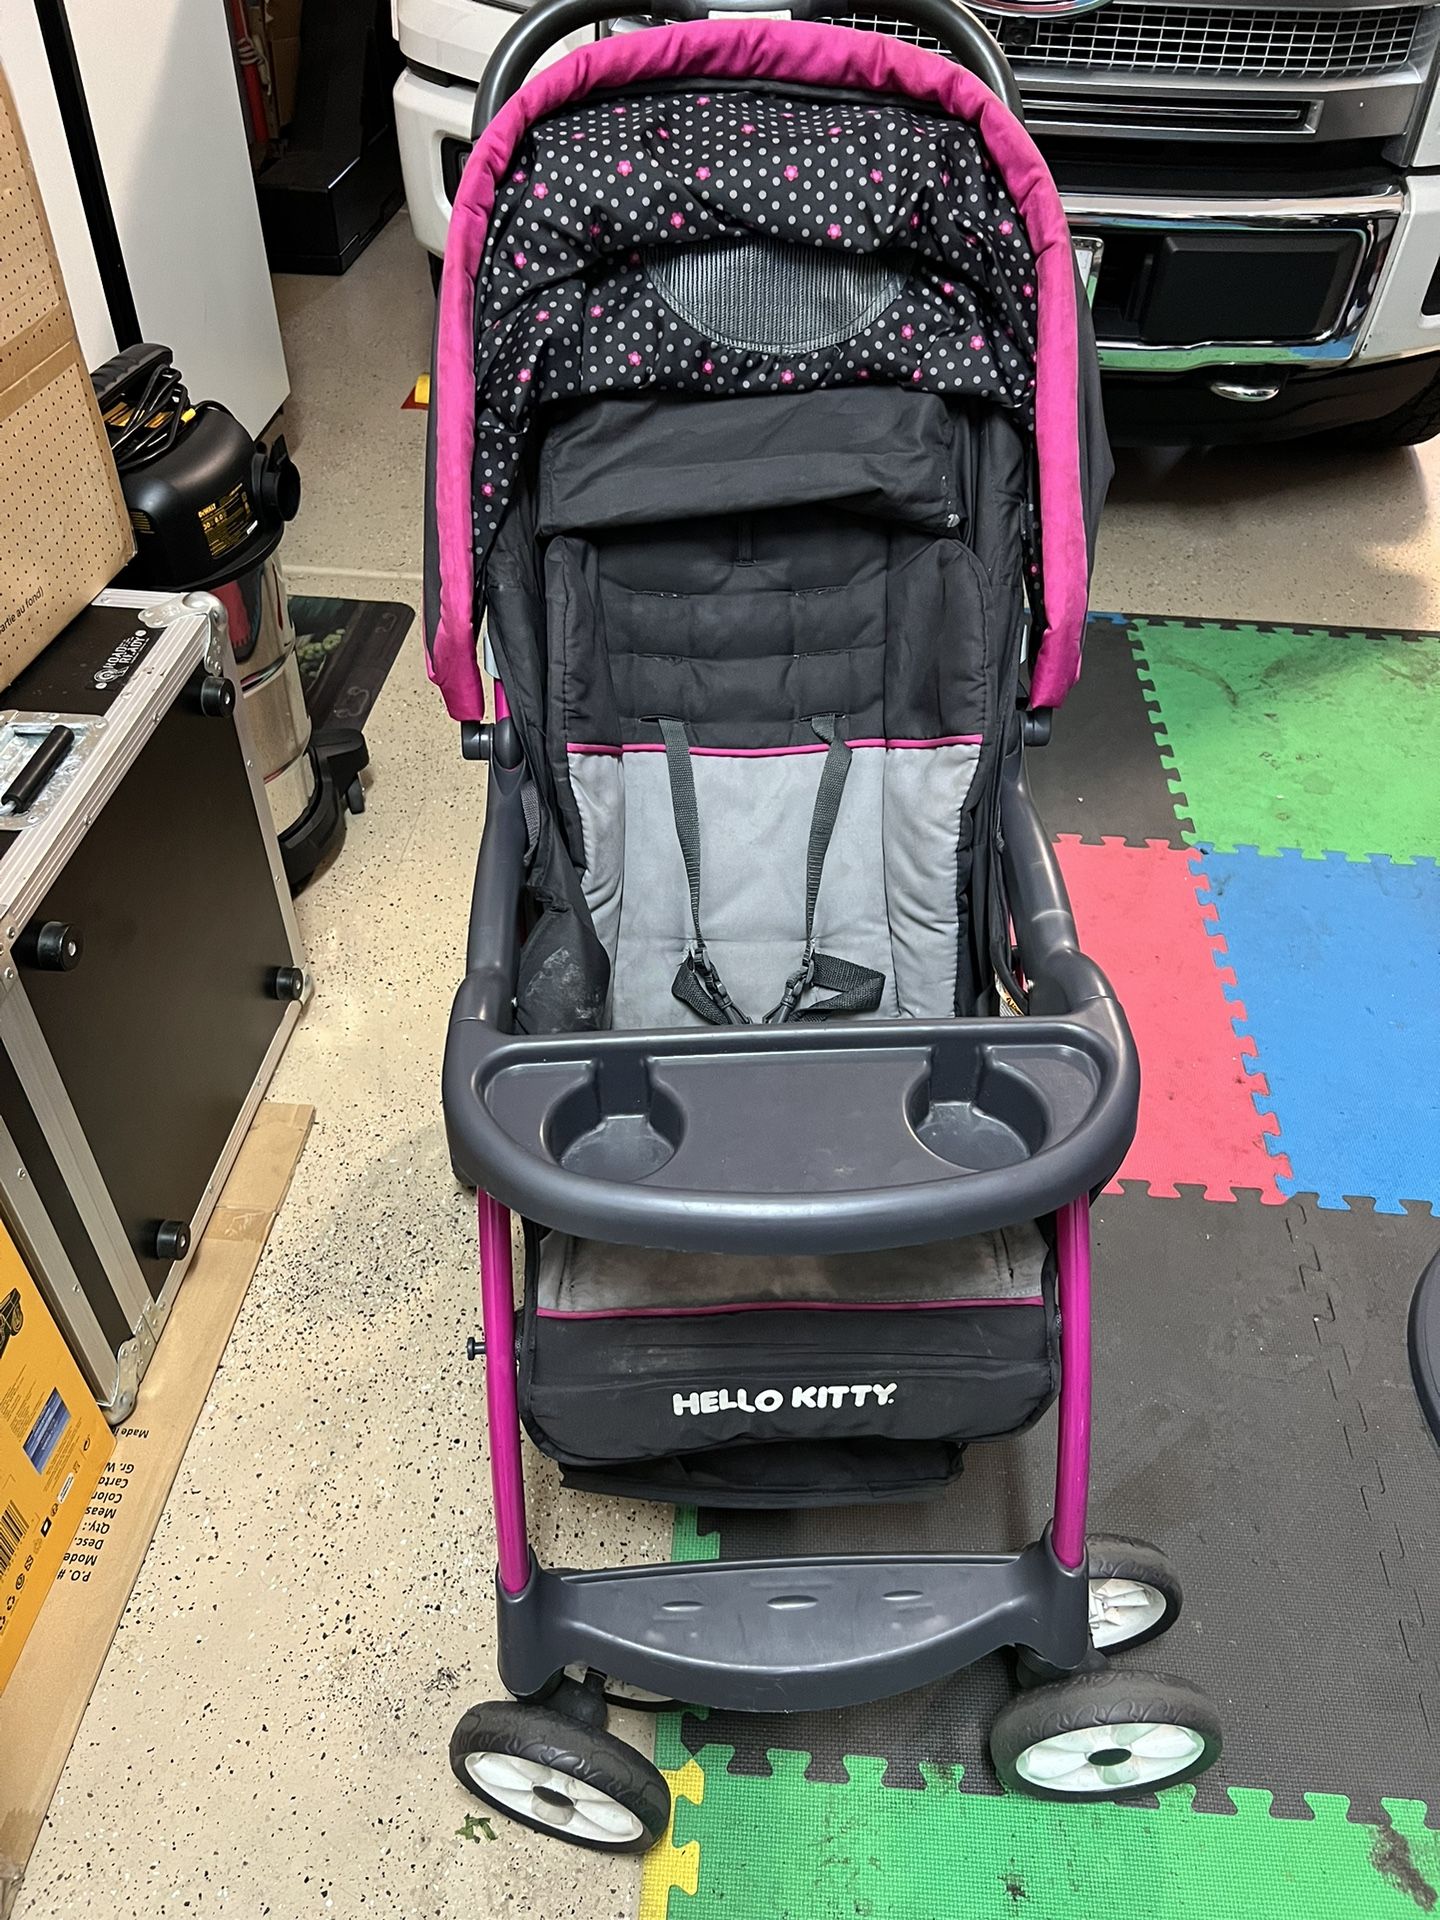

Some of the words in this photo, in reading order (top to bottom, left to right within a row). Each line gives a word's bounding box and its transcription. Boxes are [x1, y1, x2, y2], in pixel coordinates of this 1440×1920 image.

[16, 604, 26, 618] au
[25, 585, 44, 609] fond)
[102, 646, 127, 669] ROAD
[118, 636, 145, 664] READY
[672, 1388, 783, 1416] HELLO
[121, 1427, 150, 1439] Made
[119, 1462, 135, 1474] Gr.
[84, 1506, 117, 1519] Meas
[74, 1537, 104, 1550] Desc.
